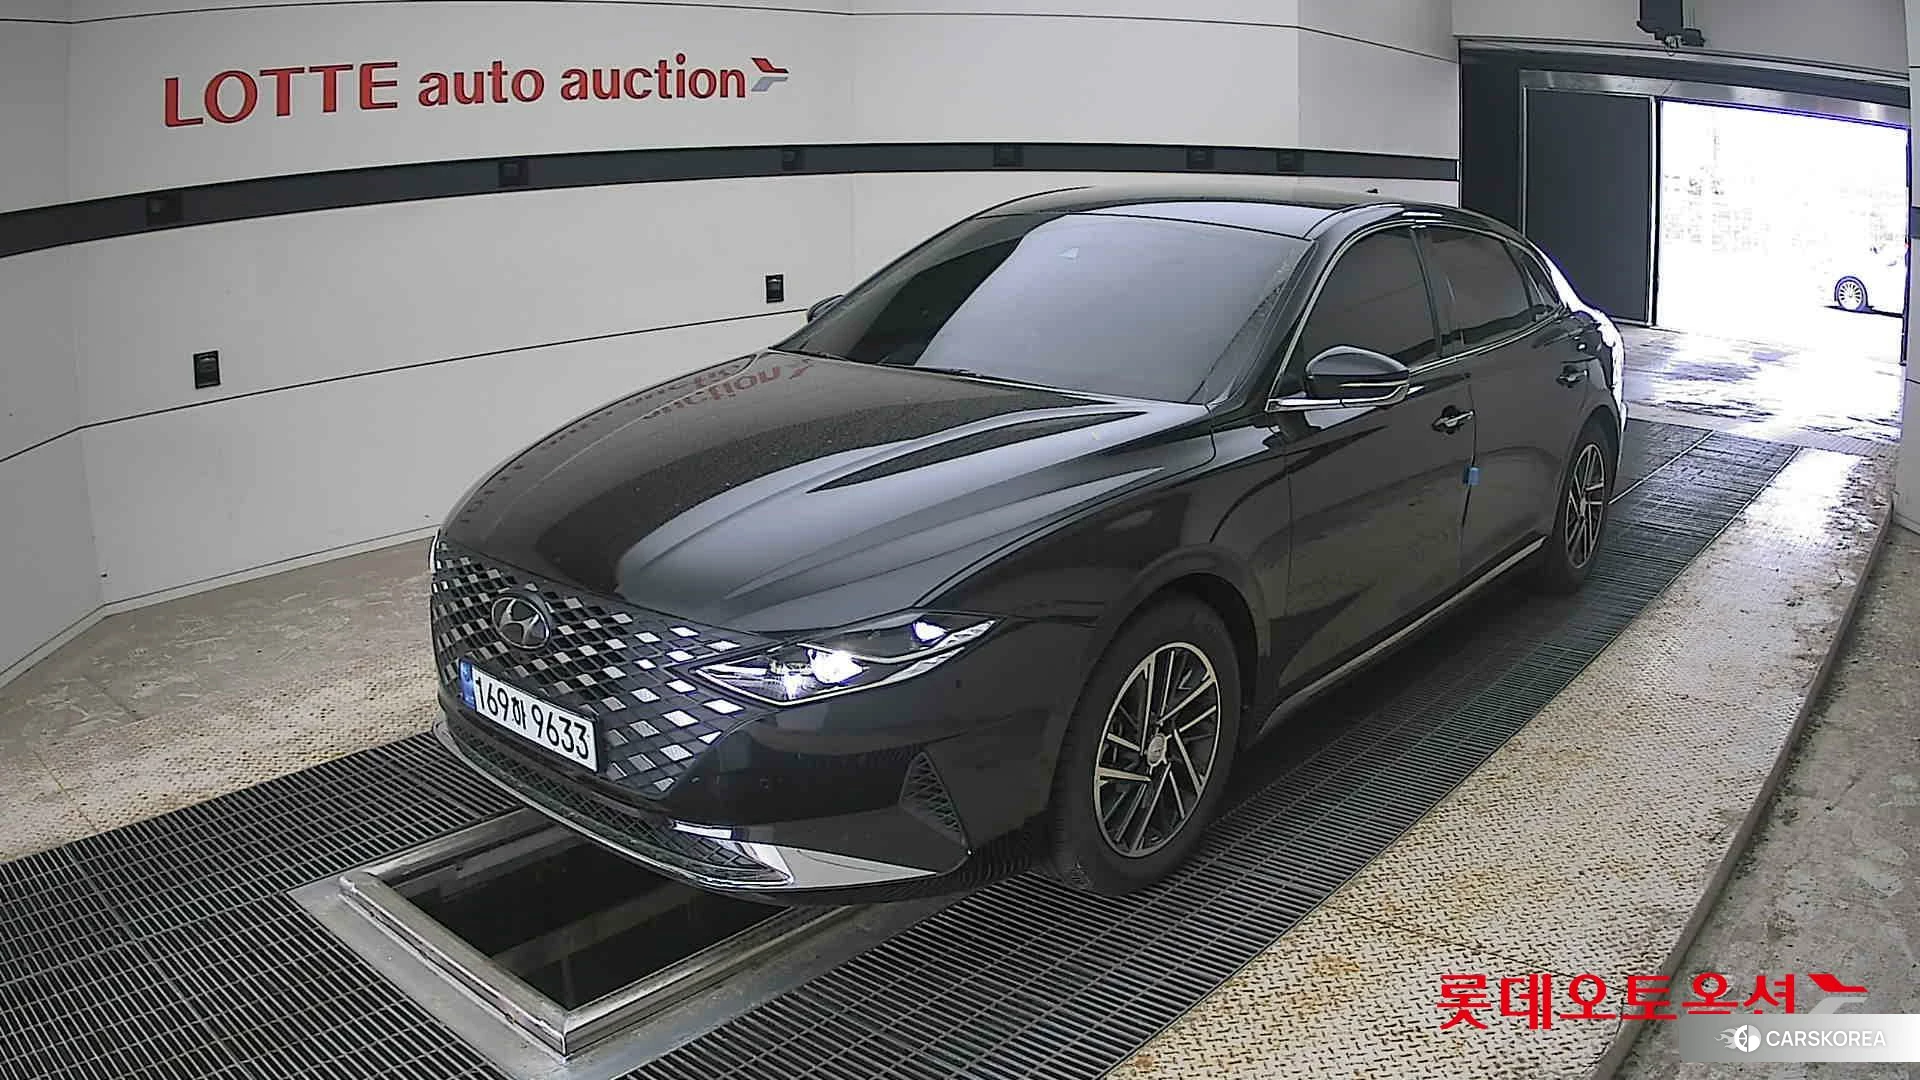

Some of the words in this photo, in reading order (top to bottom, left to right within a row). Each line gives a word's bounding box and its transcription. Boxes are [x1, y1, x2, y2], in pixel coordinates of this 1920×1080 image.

[164, 61, 399, 127] LOTTE
[418, 59, 545, 107] auto
[561, 53, 746, 101] auction
[531, 703, 589, 760] 9633
